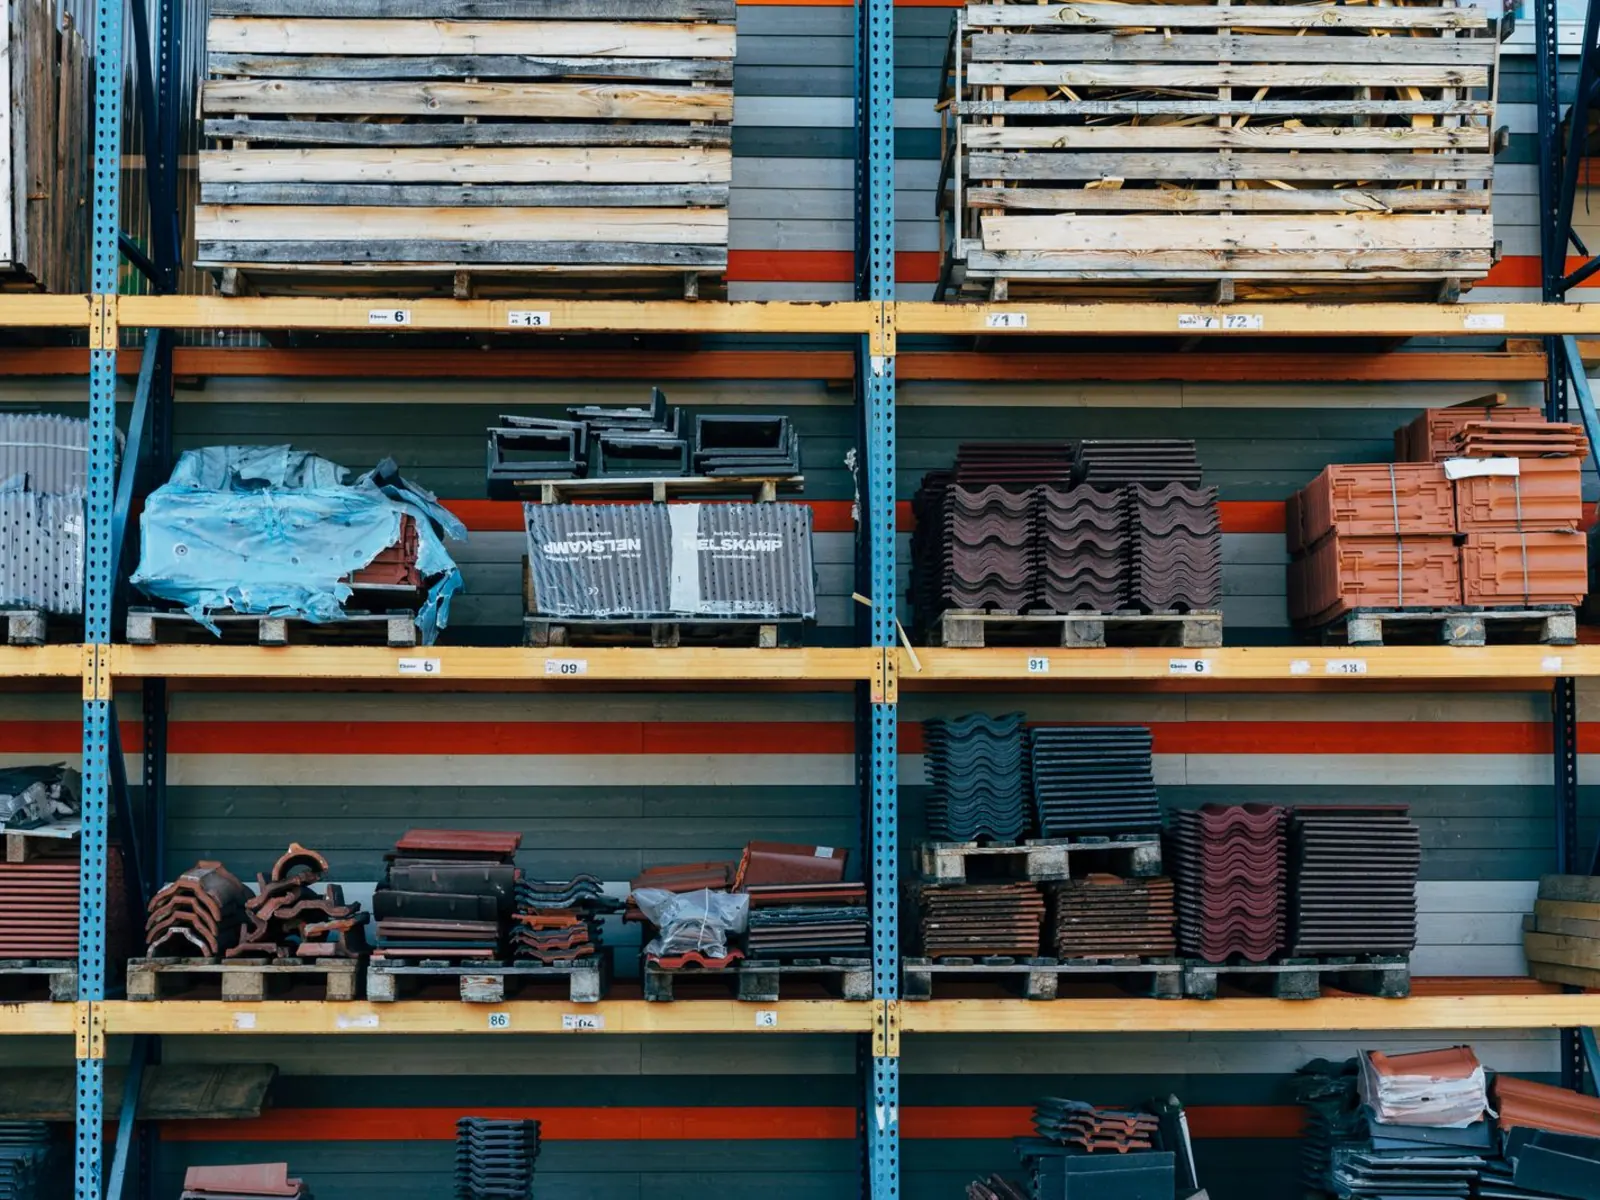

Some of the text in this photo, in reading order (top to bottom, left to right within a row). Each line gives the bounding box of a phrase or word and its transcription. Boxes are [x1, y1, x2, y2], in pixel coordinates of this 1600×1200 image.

[395, 311, 404, 322] 6
[525, 316, 541, 325] 13
[1226, 316, 1247, 327] 72
[543, 538, 642, 554] NELSKAMP
[424, 661, 434, 672] 6
[561, 663, 577, 674] 09
[1030, 659, 1043, 670] 91
[1195, 660, 1204, 672] 6
[491, 1015, 506, 1026] 86
